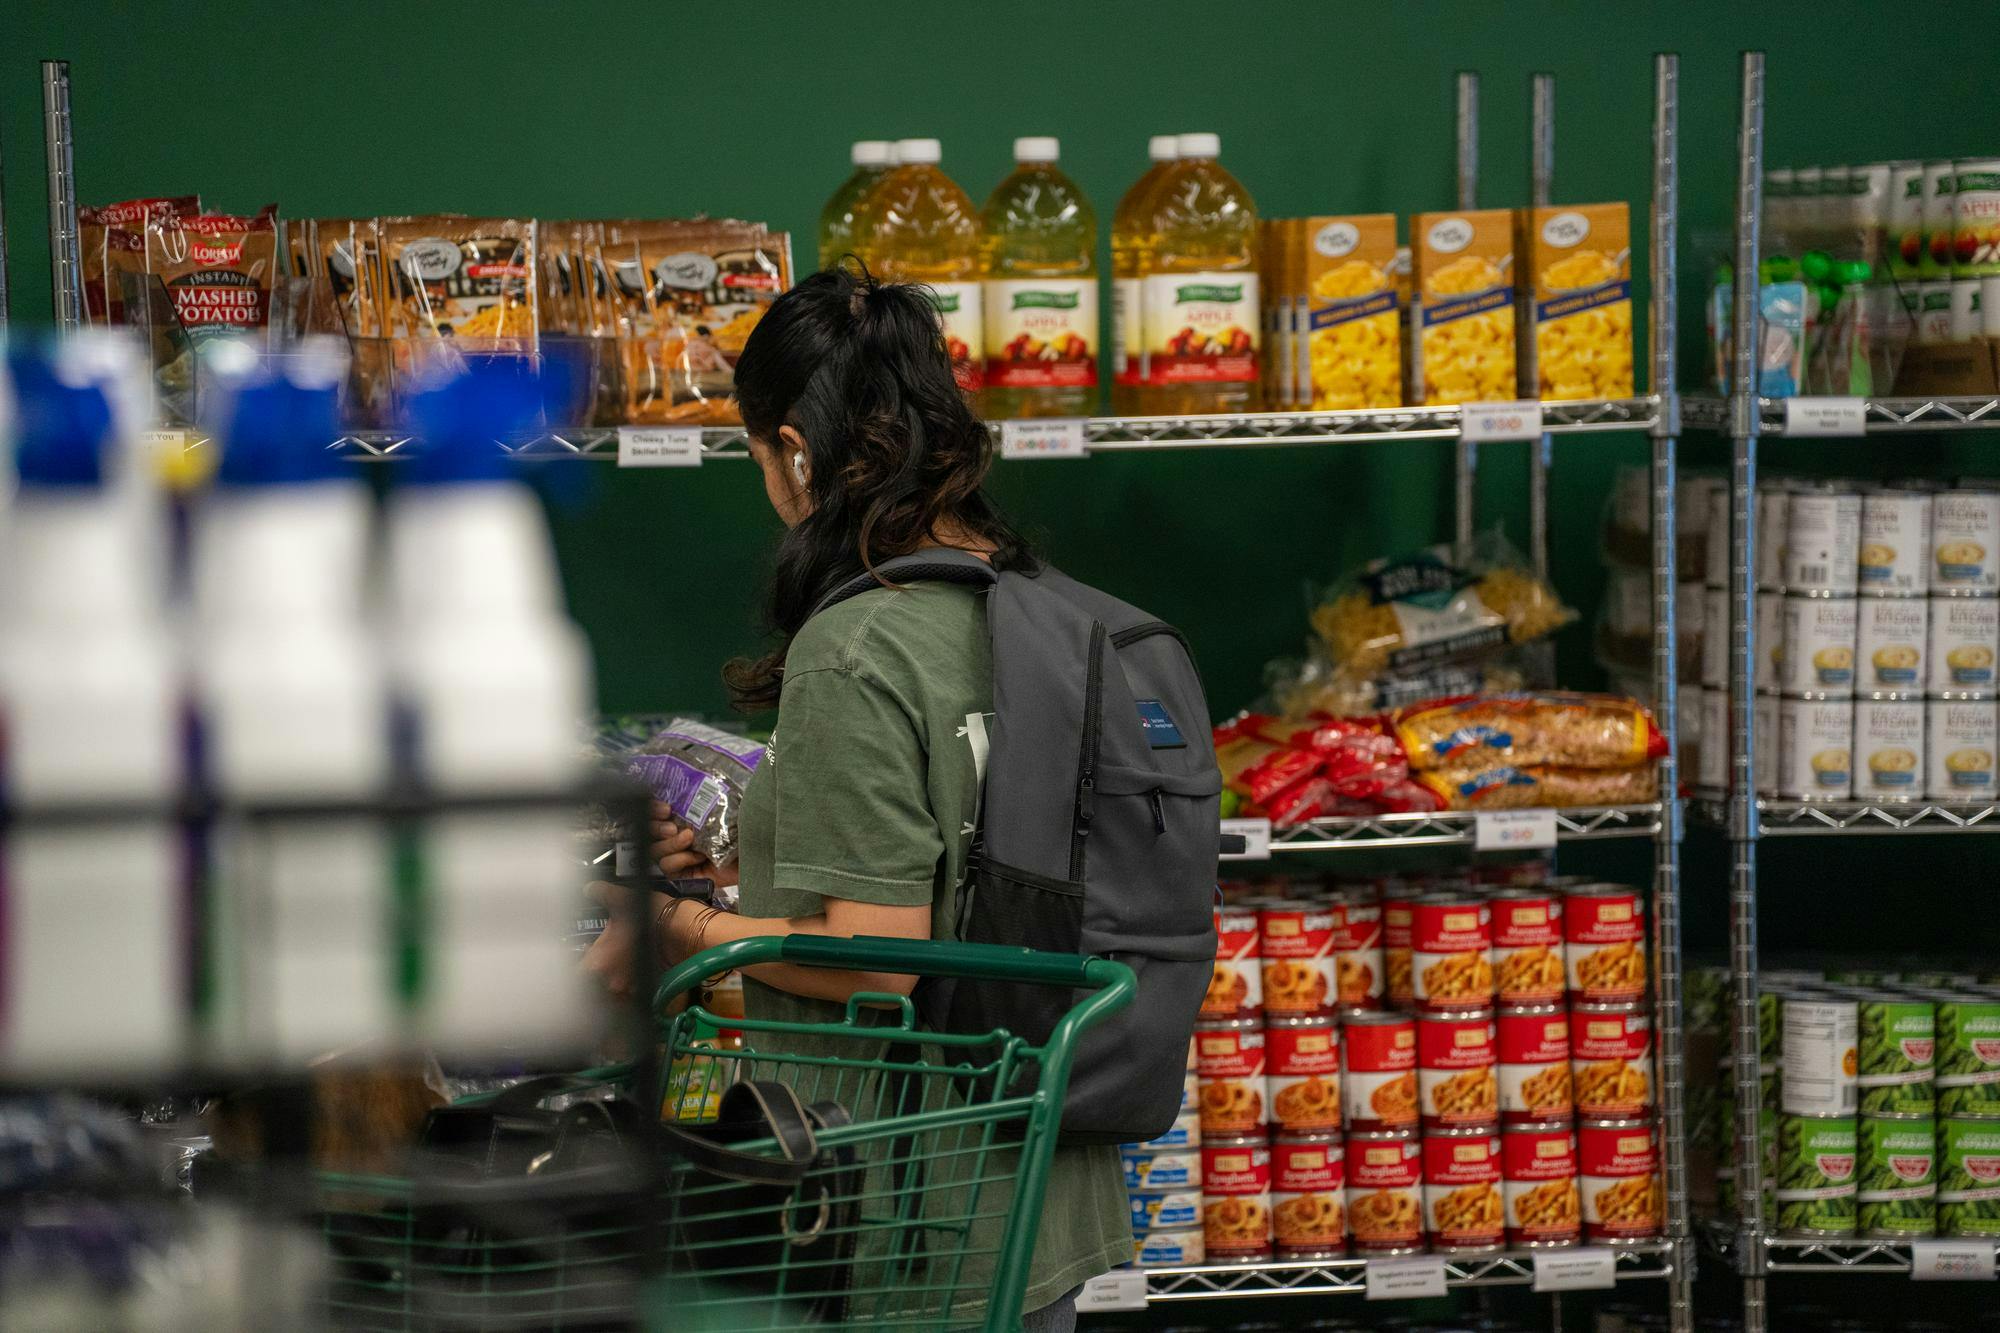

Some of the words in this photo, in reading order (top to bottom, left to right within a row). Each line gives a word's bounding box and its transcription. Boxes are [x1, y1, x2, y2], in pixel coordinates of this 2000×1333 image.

[177, 288, 259, 306] MASHED
[174, 305, 262, 322] POTATOES
[156, 433, 175, 441] You
